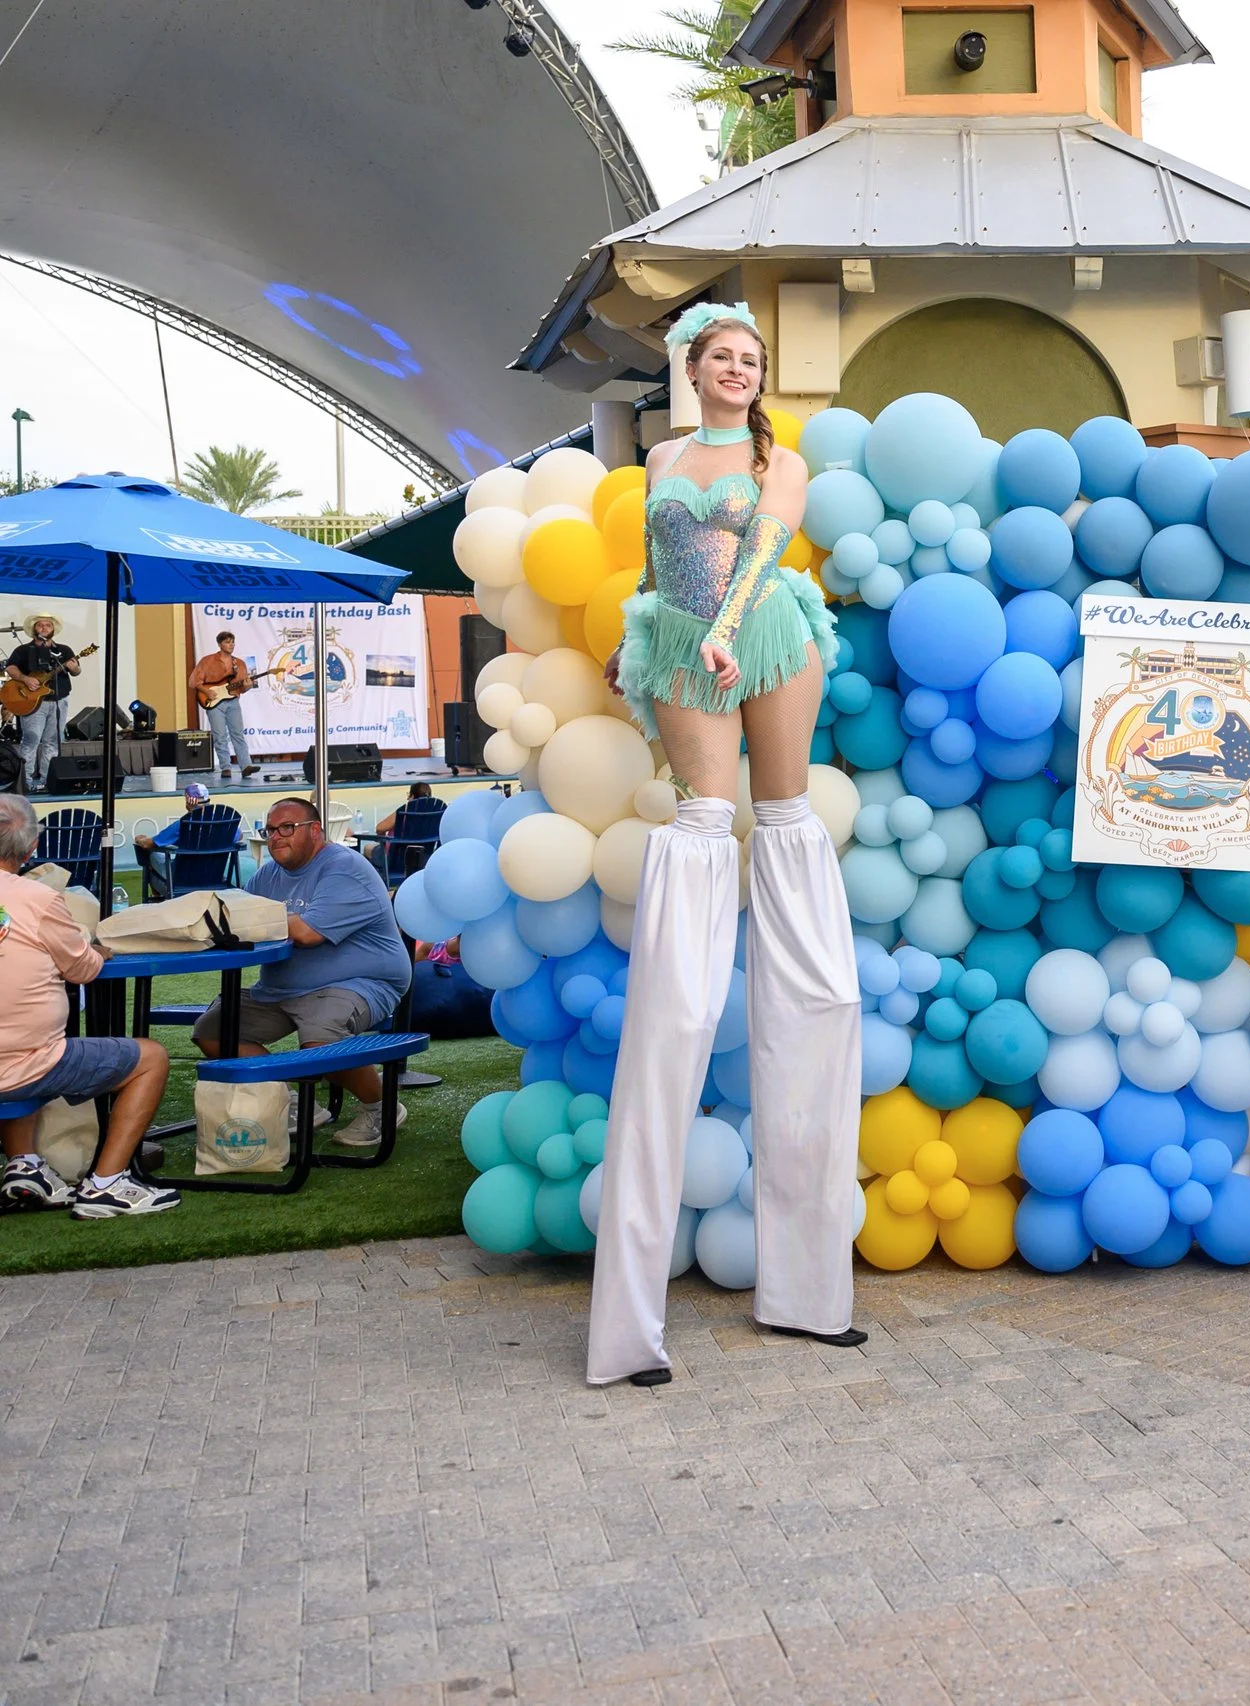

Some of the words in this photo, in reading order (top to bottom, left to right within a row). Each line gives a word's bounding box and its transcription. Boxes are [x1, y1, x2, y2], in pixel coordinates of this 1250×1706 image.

[204, 604, 234, 620] City
[239, 606, 255, 620] of
[258, 606, 304, 619] Destin
[377, 604, 412, 616] Bash
[1155, 675, 1173, 685] CITY
[1192, 673, 1221, 688] DESTIN
[257, 728, 280, 736] Years
[283, 727, 293, 736] of
[336, 723, 388, 733] Community
[1157, 732, 1210, 754] BIRTHDAY
[1118, 806, 1131, 815] AT
[1132, 814, 1199, 833] HARBORWALK
[1203, 812, 1242, 830] VILLAGE
[1139, 807, 1184, 822] CELEBRATE
[1102, 824, 1126, 837] VOTED
[1152, 848, 1173, 859] BEST
[1174, 849, 1206, 862] HARBOR
